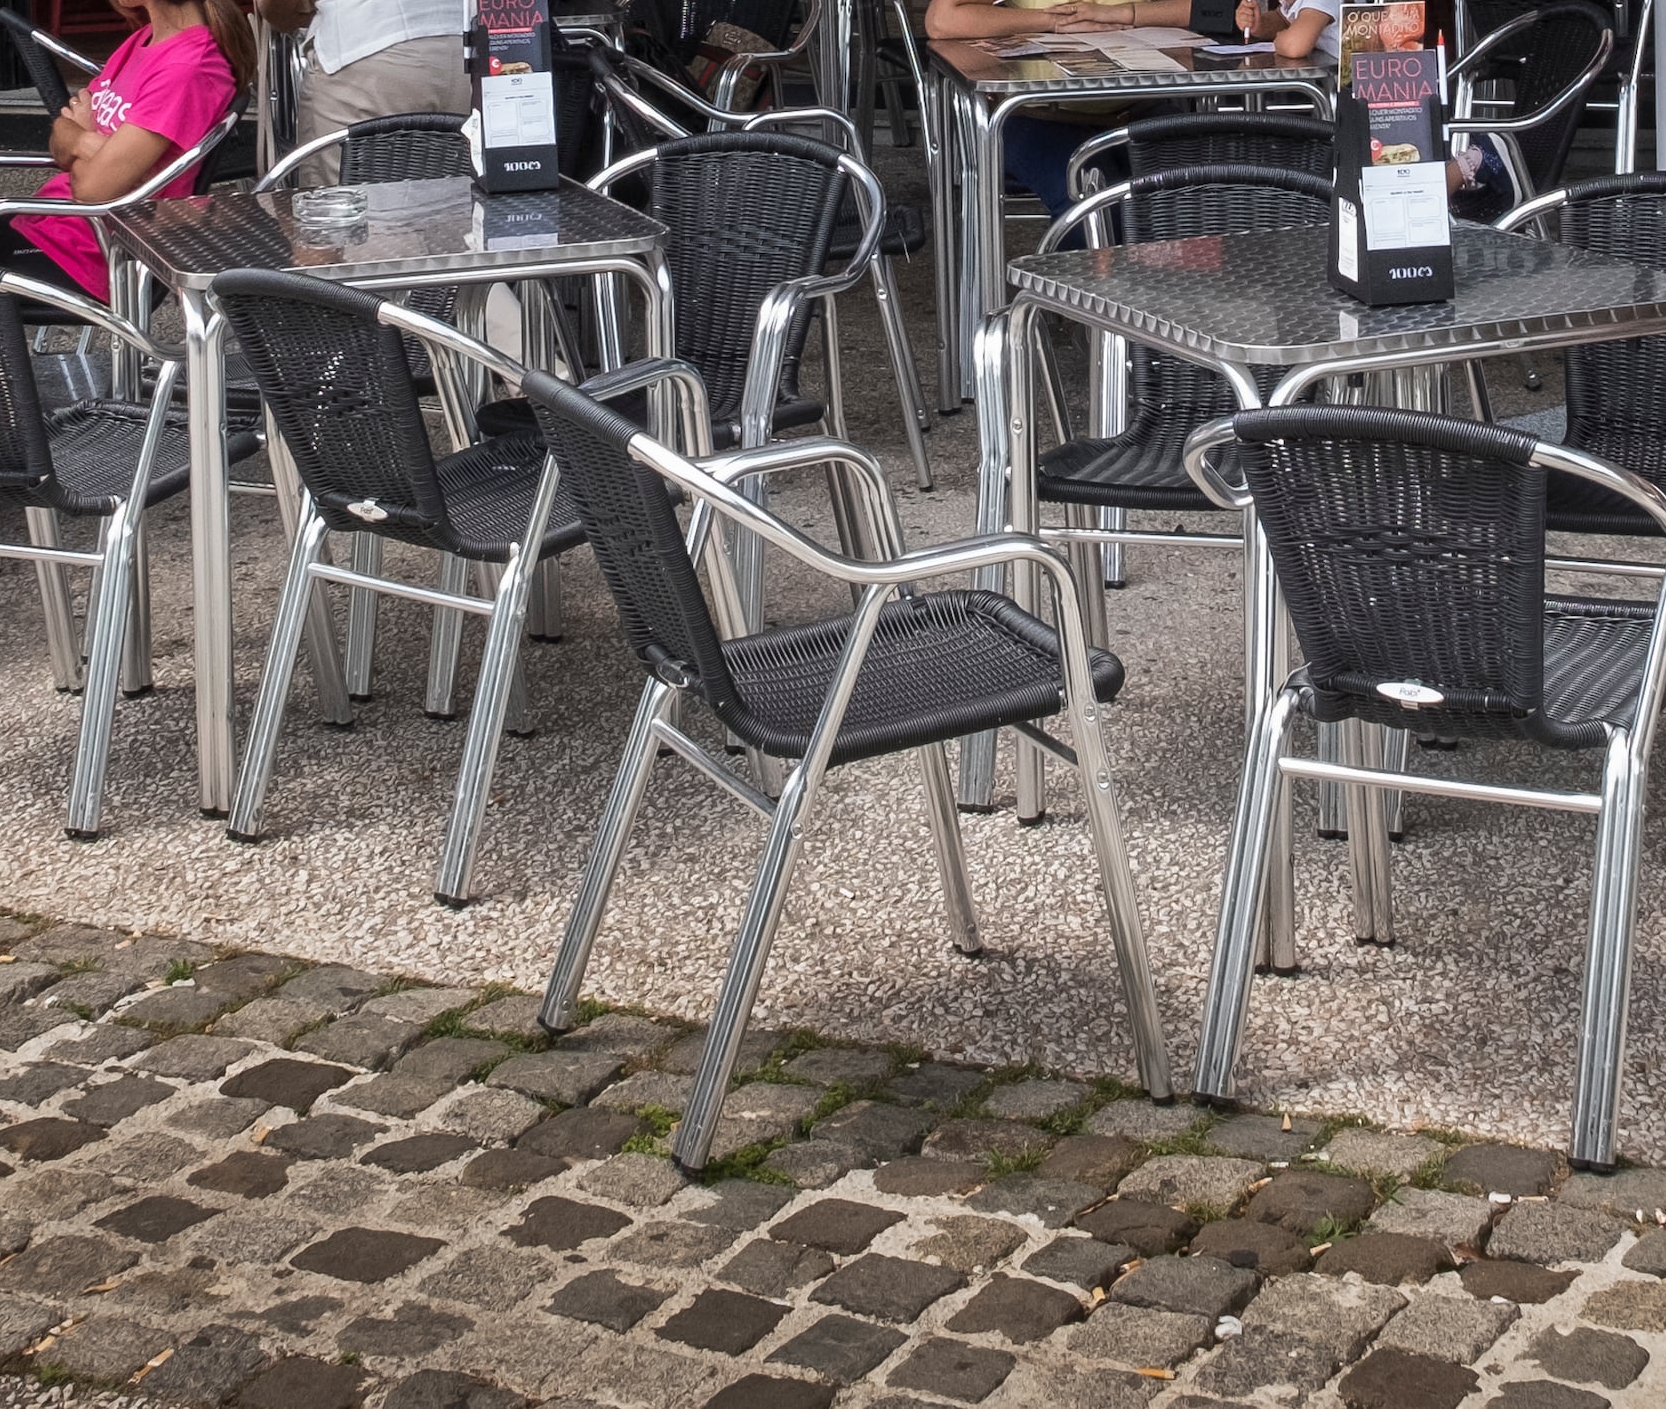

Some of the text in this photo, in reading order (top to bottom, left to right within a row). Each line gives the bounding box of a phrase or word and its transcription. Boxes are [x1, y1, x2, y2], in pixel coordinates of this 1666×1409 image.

[480, 10, 545, 29] MANIA
[1356, 57, 1422, 80] EURO
[1357, 80, 1434, 102] MANIA
